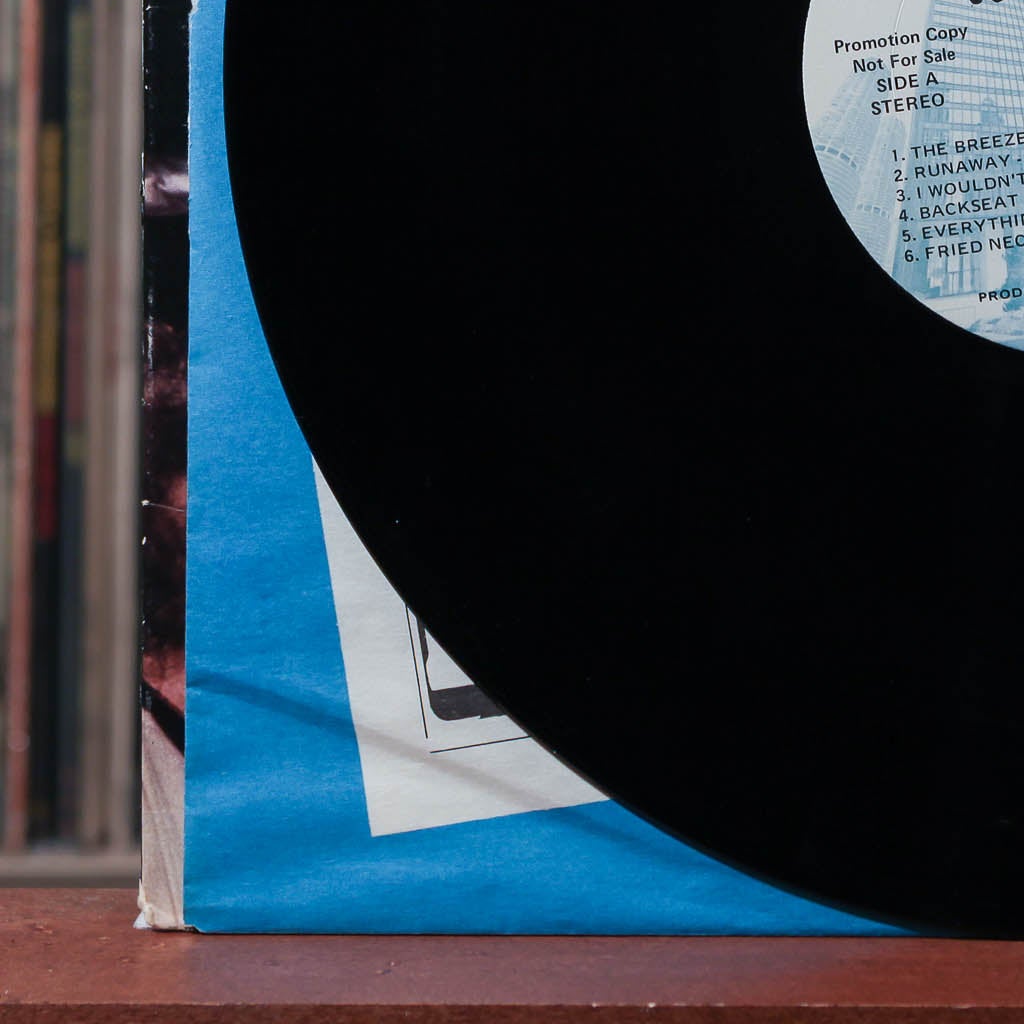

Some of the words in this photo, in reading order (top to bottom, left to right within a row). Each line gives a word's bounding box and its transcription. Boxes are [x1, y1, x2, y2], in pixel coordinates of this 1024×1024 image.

[834, 33, 920, 54] Promotion
[926, 26, 968, 41] Copy
[853, 58, 884, 74] Not
[890, 53, 918, 69] For
[923, 48, 956, 64] Sale
[876, 74, 920, 92] SIDE
[926, 72, 939, 86] A
[871, 93, 945, 116] STEREO
[892, 149, 906, 162] 1.
[911, 142, 948, 159] THE
[894, 169, 908, 182] 2.
[914, 154, 1010, 179] RUNAWAY
[896, 189, 911, 202] 3.
[917, 187, 922, 199] I
[899, 209, 914, 222] 4.
[920, 194, 1019, 220] BACKSEAT
[902, 230, 917, 243] 5.
[904, 250, 919, 263] 6.
[925, 240, 983, 260] FRIED
